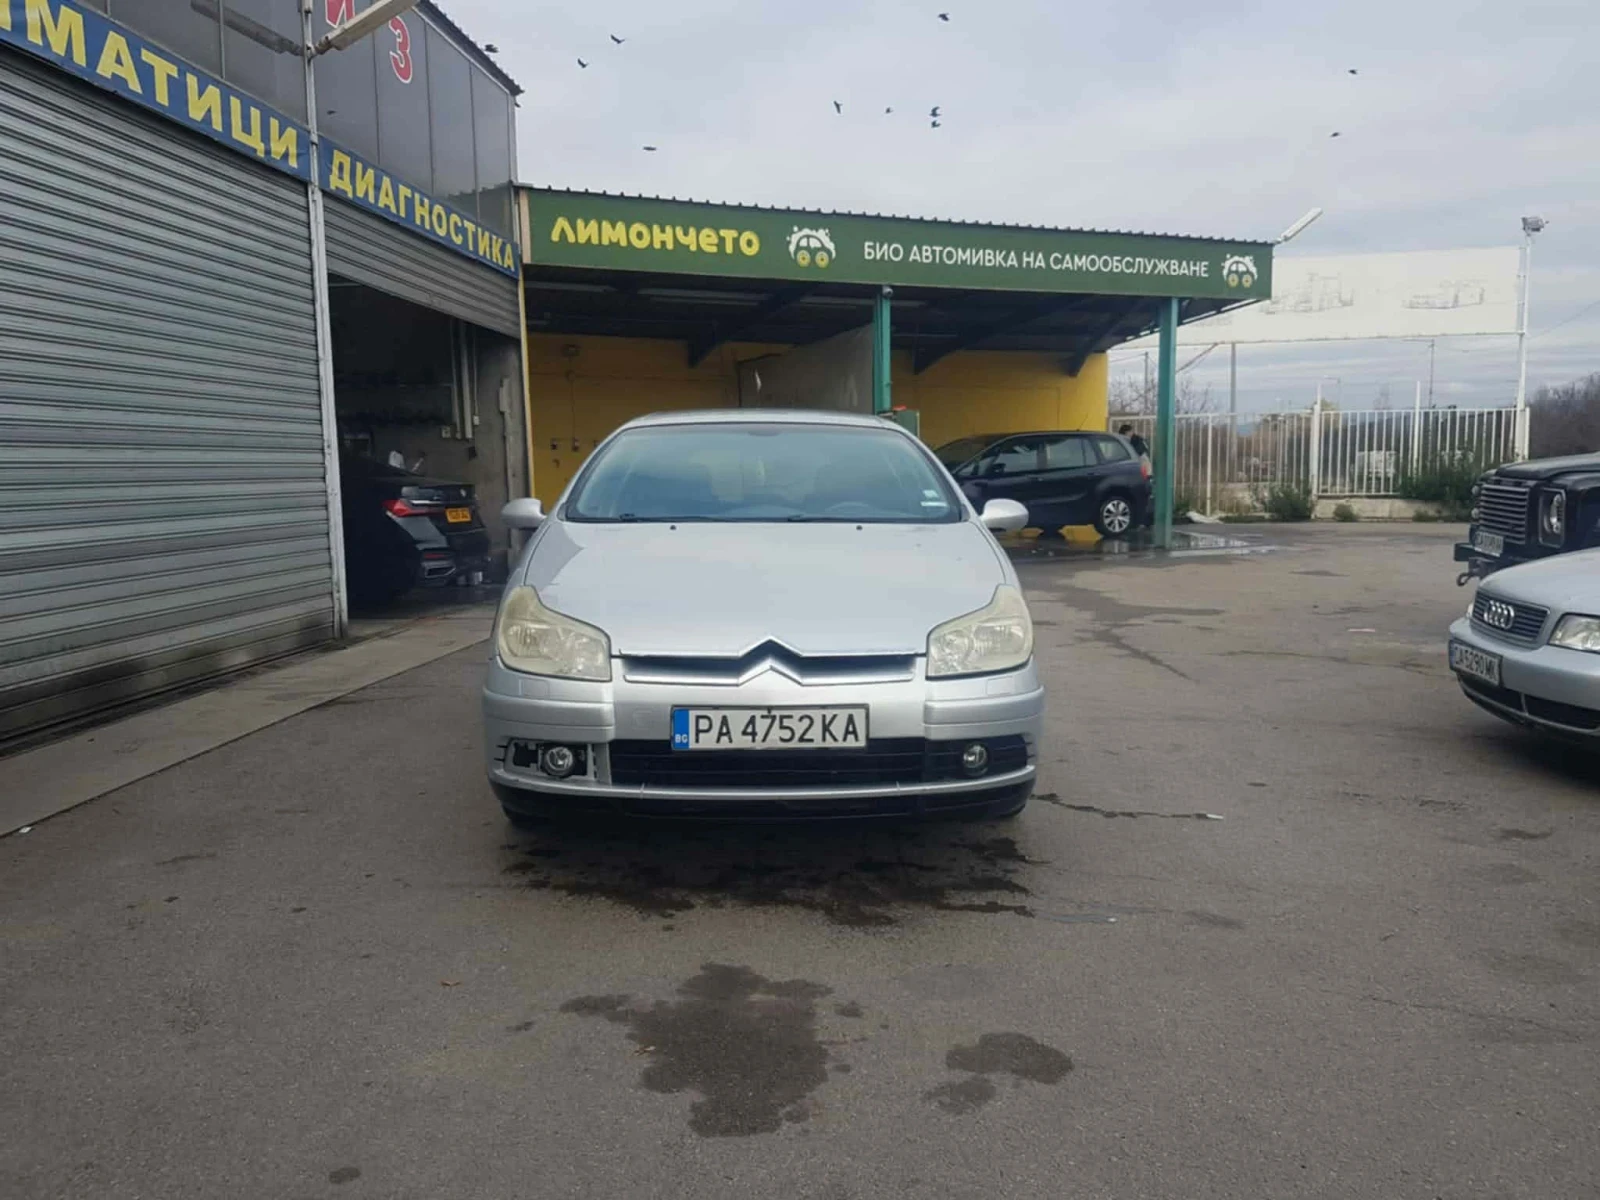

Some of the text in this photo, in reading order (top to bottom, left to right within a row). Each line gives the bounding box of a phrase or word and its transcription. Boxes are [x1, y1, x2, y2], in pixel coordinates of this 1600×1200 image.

[0, 0, 298, 169] МАТИЦИ
[330, 150, 515, 271] ДИАГНОСТИКА
[864, 241, 1209, 277] БИО АВТОМИВКА НА САМООБСЛУЖВАНЕ
[675, 734, 688, 743] BG
